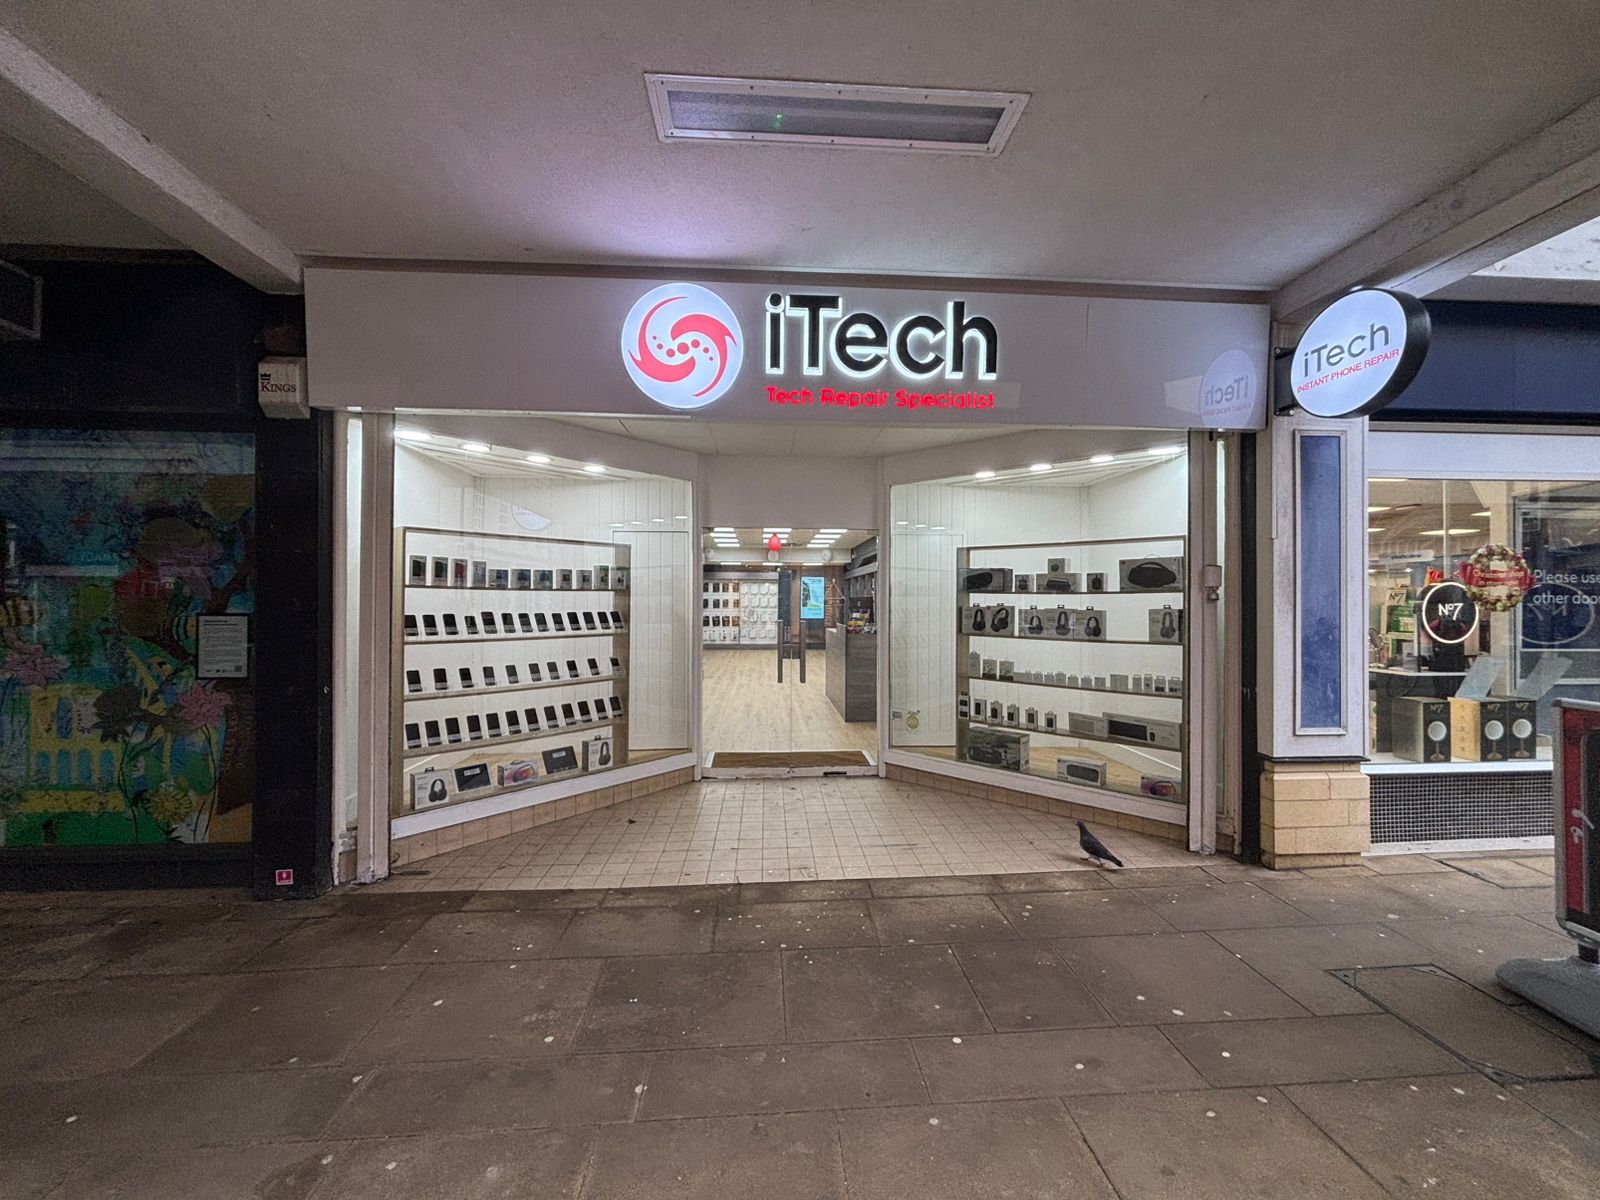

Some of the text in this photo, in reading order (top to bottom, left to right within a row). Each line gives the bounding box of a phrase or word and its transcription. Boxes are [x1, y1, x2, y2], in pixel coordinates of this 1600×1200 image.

[765, 293, 998, 380] iTech
[1303, 323, 1390, 377] iTech
[1297, 348, 1400, 393] INSTANT PHONE REPAIR
[766, 386, 995, 411] Tech Repair Specialist
[1534, 569, 1578, 584] Please
[1533, 590, 1600, 605] other doo
